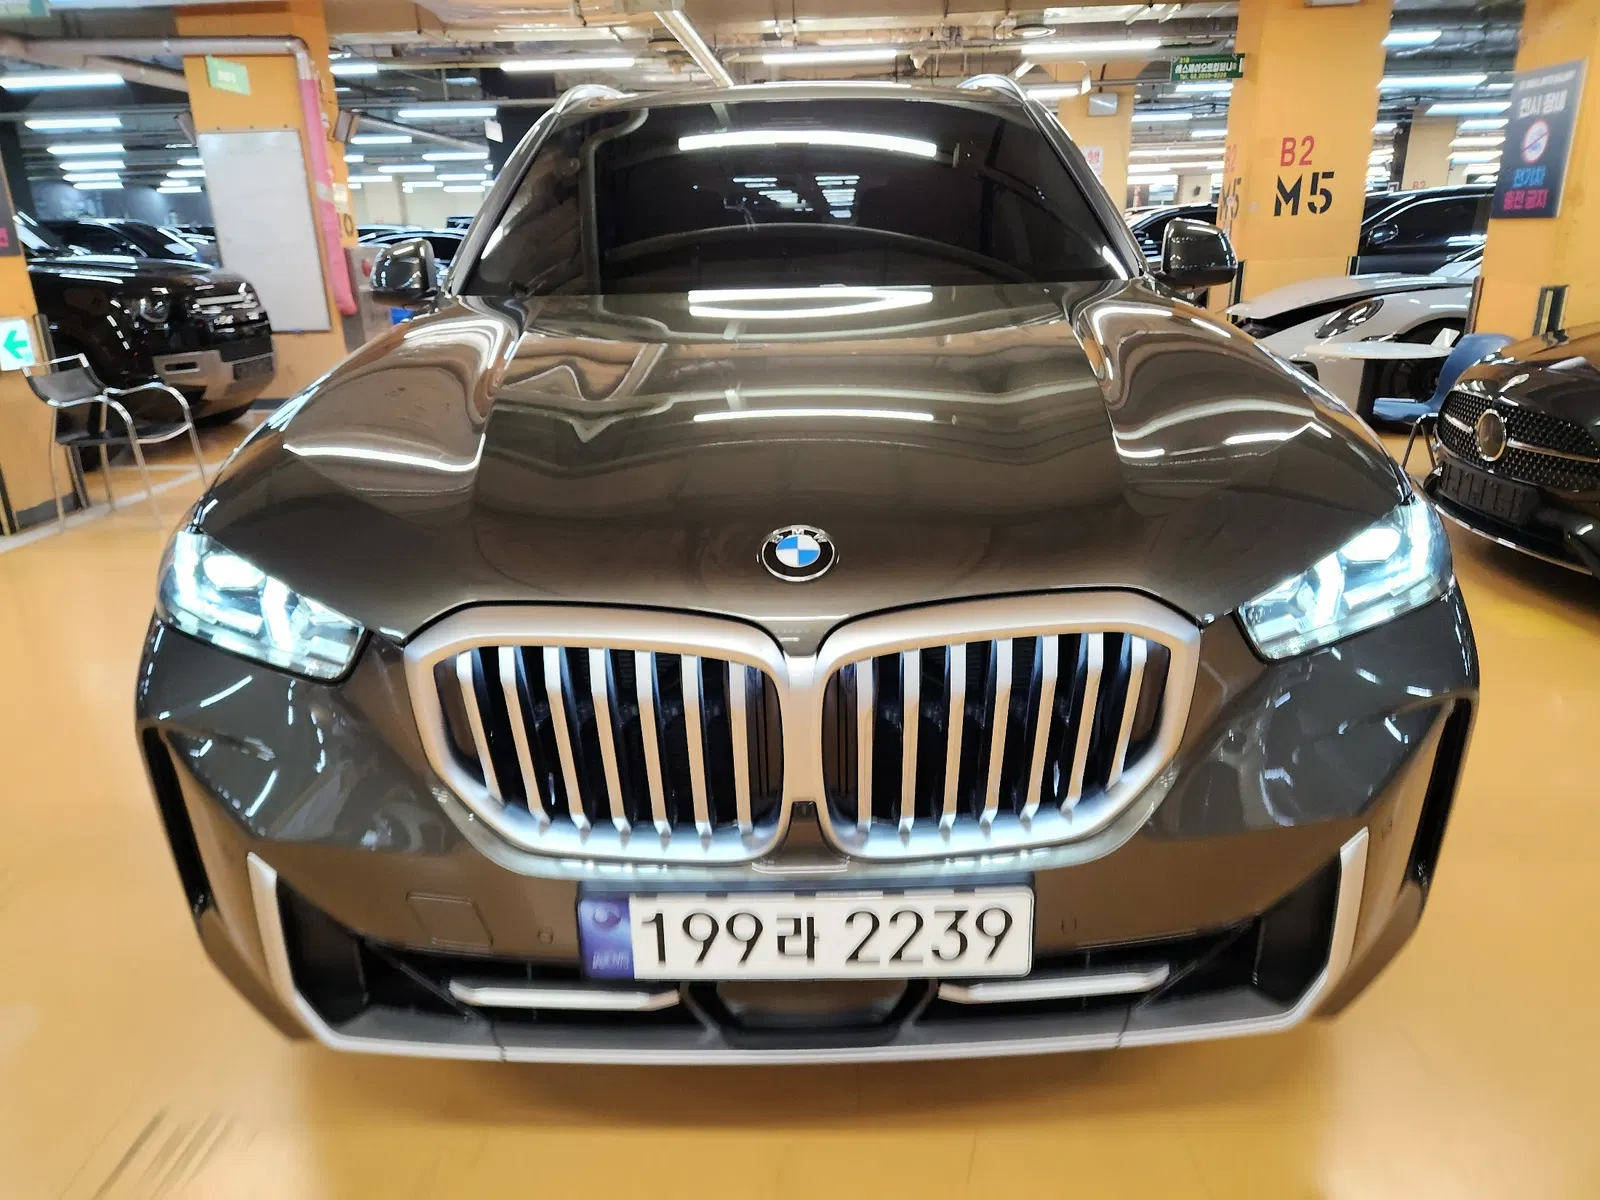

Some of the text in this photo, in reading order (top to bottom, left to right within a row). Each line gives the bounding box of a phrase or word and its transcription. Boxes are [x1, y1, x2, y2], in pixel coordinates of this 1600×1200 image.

[1280, 135, 1315, 167] B2
[1273, 171, 1335, 217] M5
[641, 907, 1014, 967] 199라 2239
